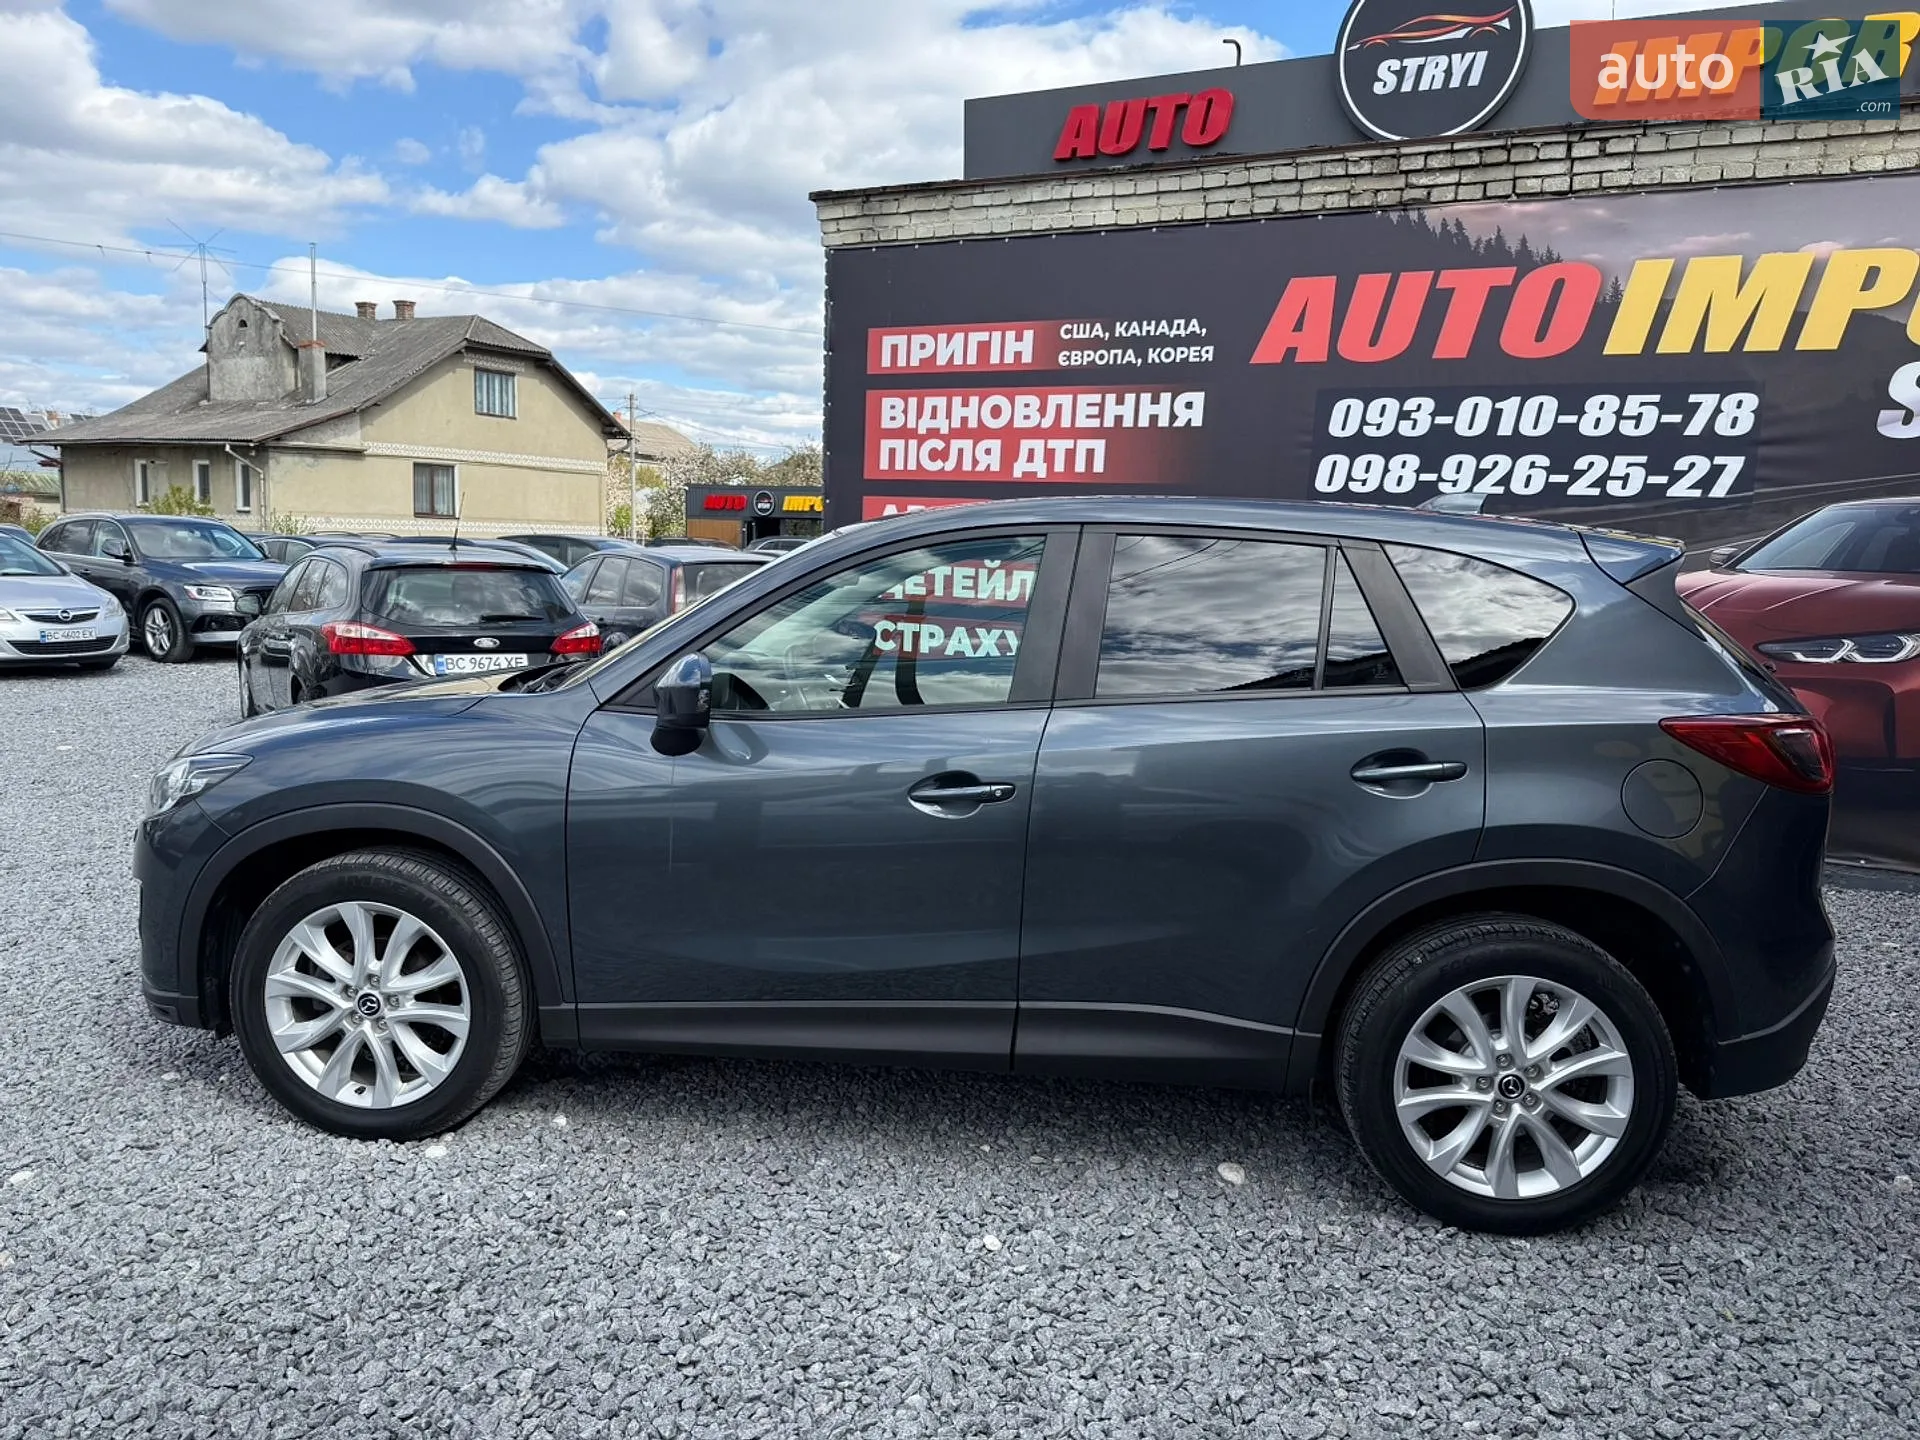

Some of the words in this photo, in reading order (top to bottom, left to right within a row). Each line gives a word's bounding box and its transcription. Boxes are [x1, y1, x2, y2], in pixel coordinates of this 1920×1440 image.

[1373, 51, 1488, 95] STRYI
[1053, 88, 1235, 161] AUTO
[1248, 248, 1920, 364] AUTOIMP
[881, 329, 1034, 368] ПРИГІН
[1060, 323, 1109, 340] США,
[1115, 318, 1206, 338] КАНАДА,
[1058, 349, 1142, 367] ЄВРОПА,
[1147, 346, 1214, 363] КОРЕЯ
[880, 391, 1205, 434] ВІДНОВЛЕННЯ
[1328, 392, 1760, 438] 093-010-85-78
[879, 438, 1002, 473] ПІСЛЯ
[1013, 438, 1106, 478] ДТП
[1314, 454, 1746, 499] 098-926-25-27
[445, 657, 466, 671] BC
[469, 656, 501, 670] 9674
